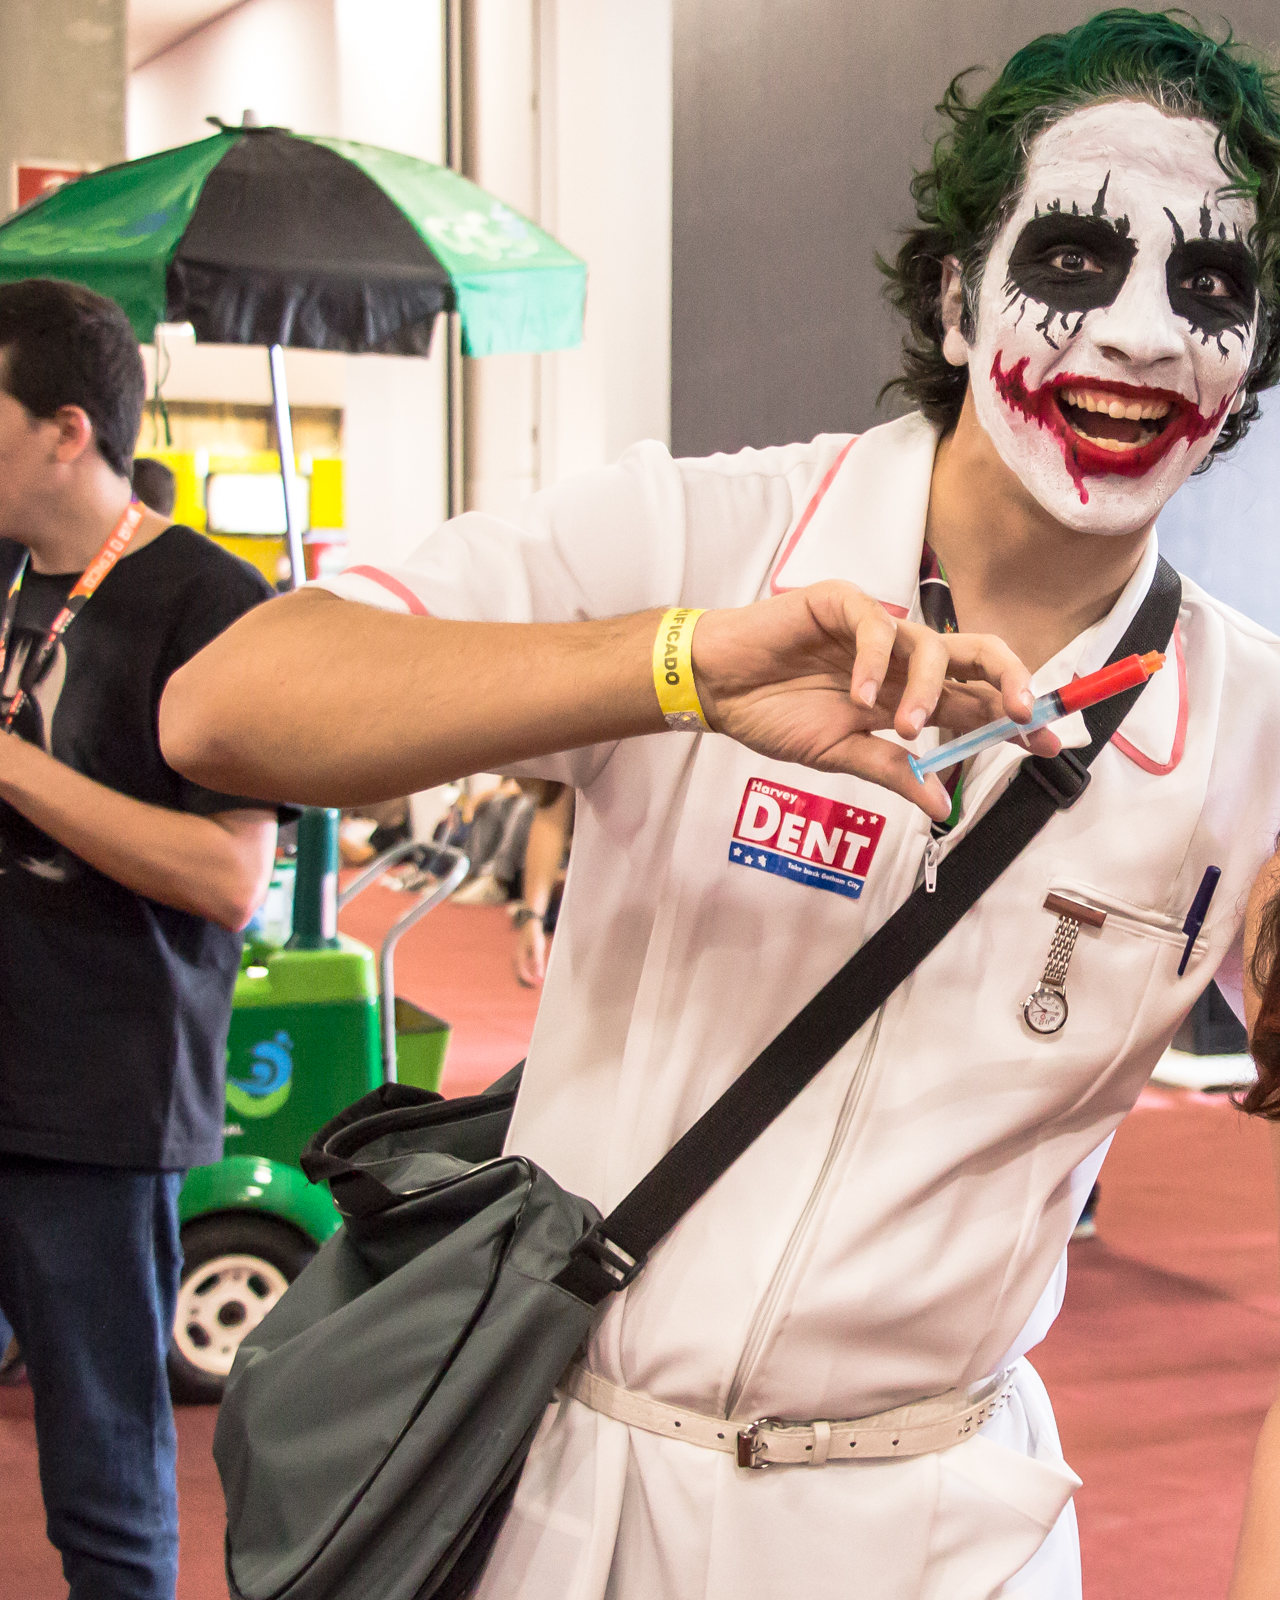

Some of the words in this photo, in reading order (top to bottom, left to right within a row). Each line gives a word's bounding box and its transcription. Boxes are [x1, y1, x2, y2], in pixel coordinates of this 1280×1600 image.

[751, 780, 799, 804] Harvey
[738, 791, 871, 871] DENT
[788, 862, 802, 872] Take
[803, 867, 820, 878] back
[821, 873, 846, 885] Gotham
[847, 880, 860, 891] City
